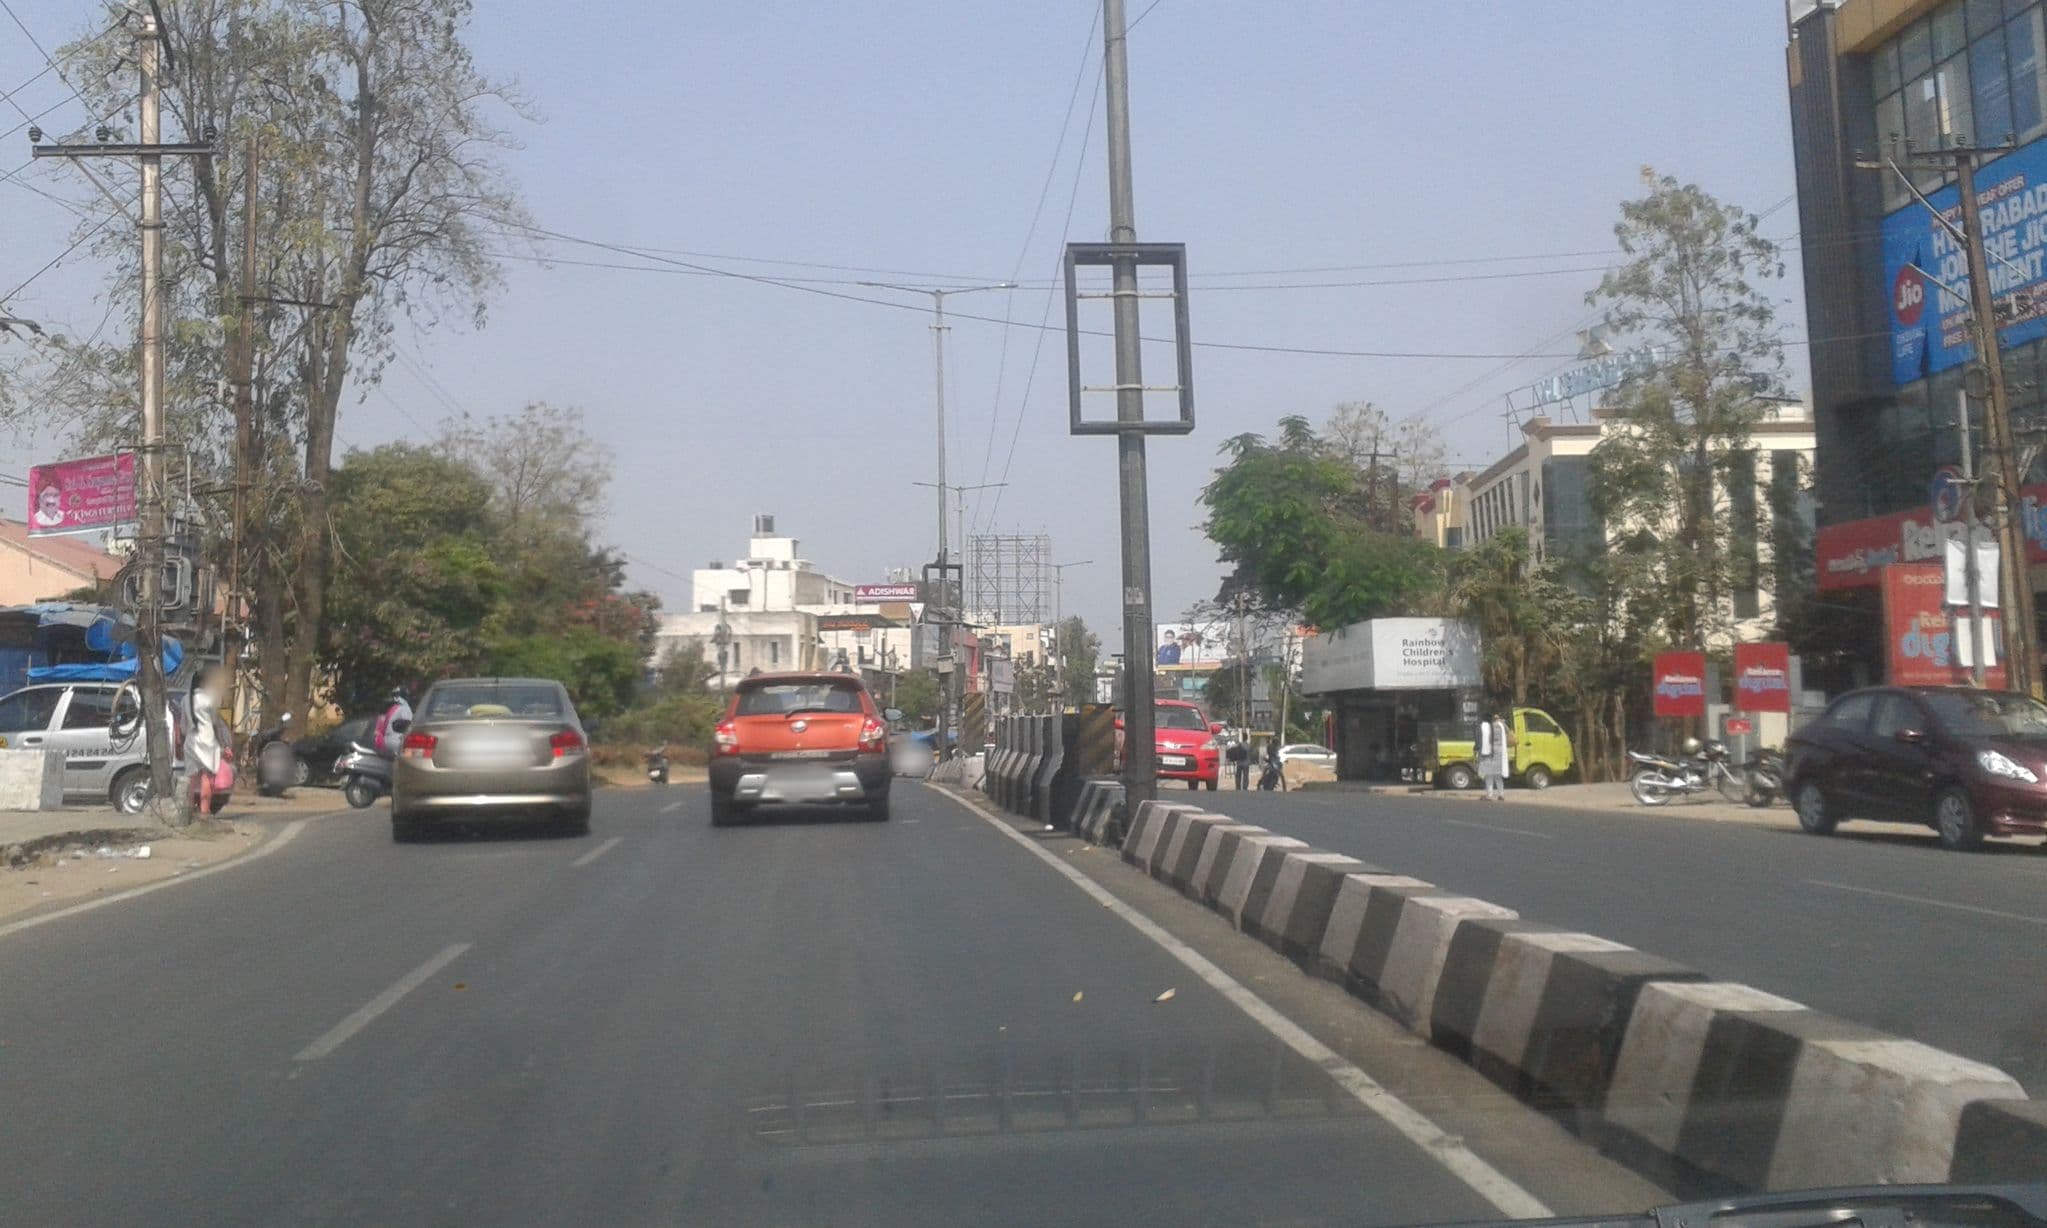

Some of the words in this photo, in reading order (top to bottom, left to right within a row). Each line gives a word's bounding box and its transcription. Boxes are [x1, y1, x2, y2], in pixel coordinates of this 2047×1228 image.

[1898, 279, 1923, 310] Jio
[868, 587, 915, 595] ADISHWAR
[1402, 639, 1445, 647] Rainbow
[1402, 648, 1454, 656] Children's
[1403, 658, 1446, 667] Hospital
